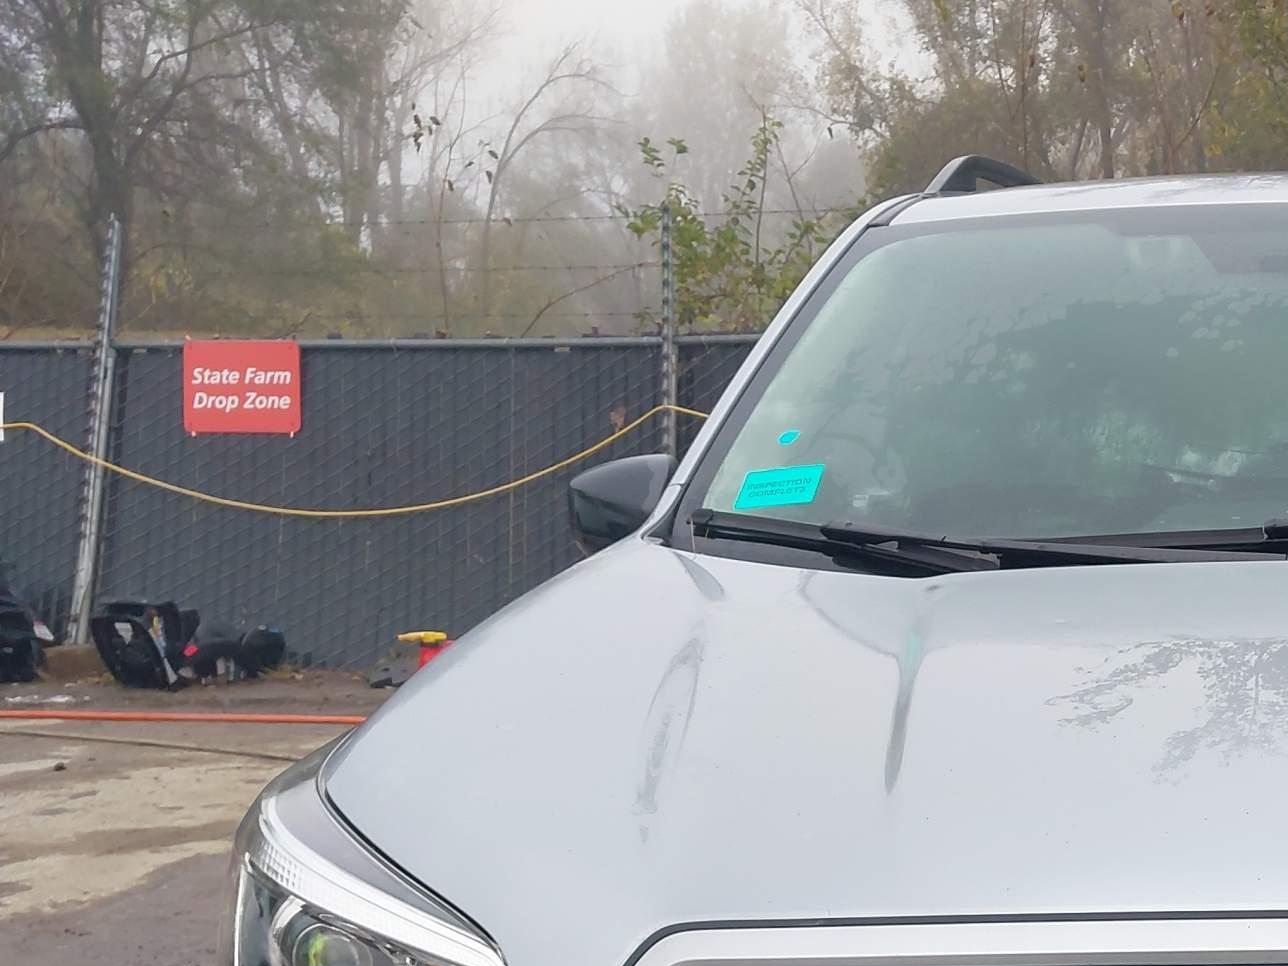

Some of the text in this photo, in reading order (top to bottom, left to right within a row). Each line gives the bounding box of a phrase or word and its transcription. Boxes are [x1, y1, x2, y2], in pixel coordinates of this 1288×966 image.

[191, 367, 292, 385] State Farm
[192, 391, 291, 413] Drop Zone
